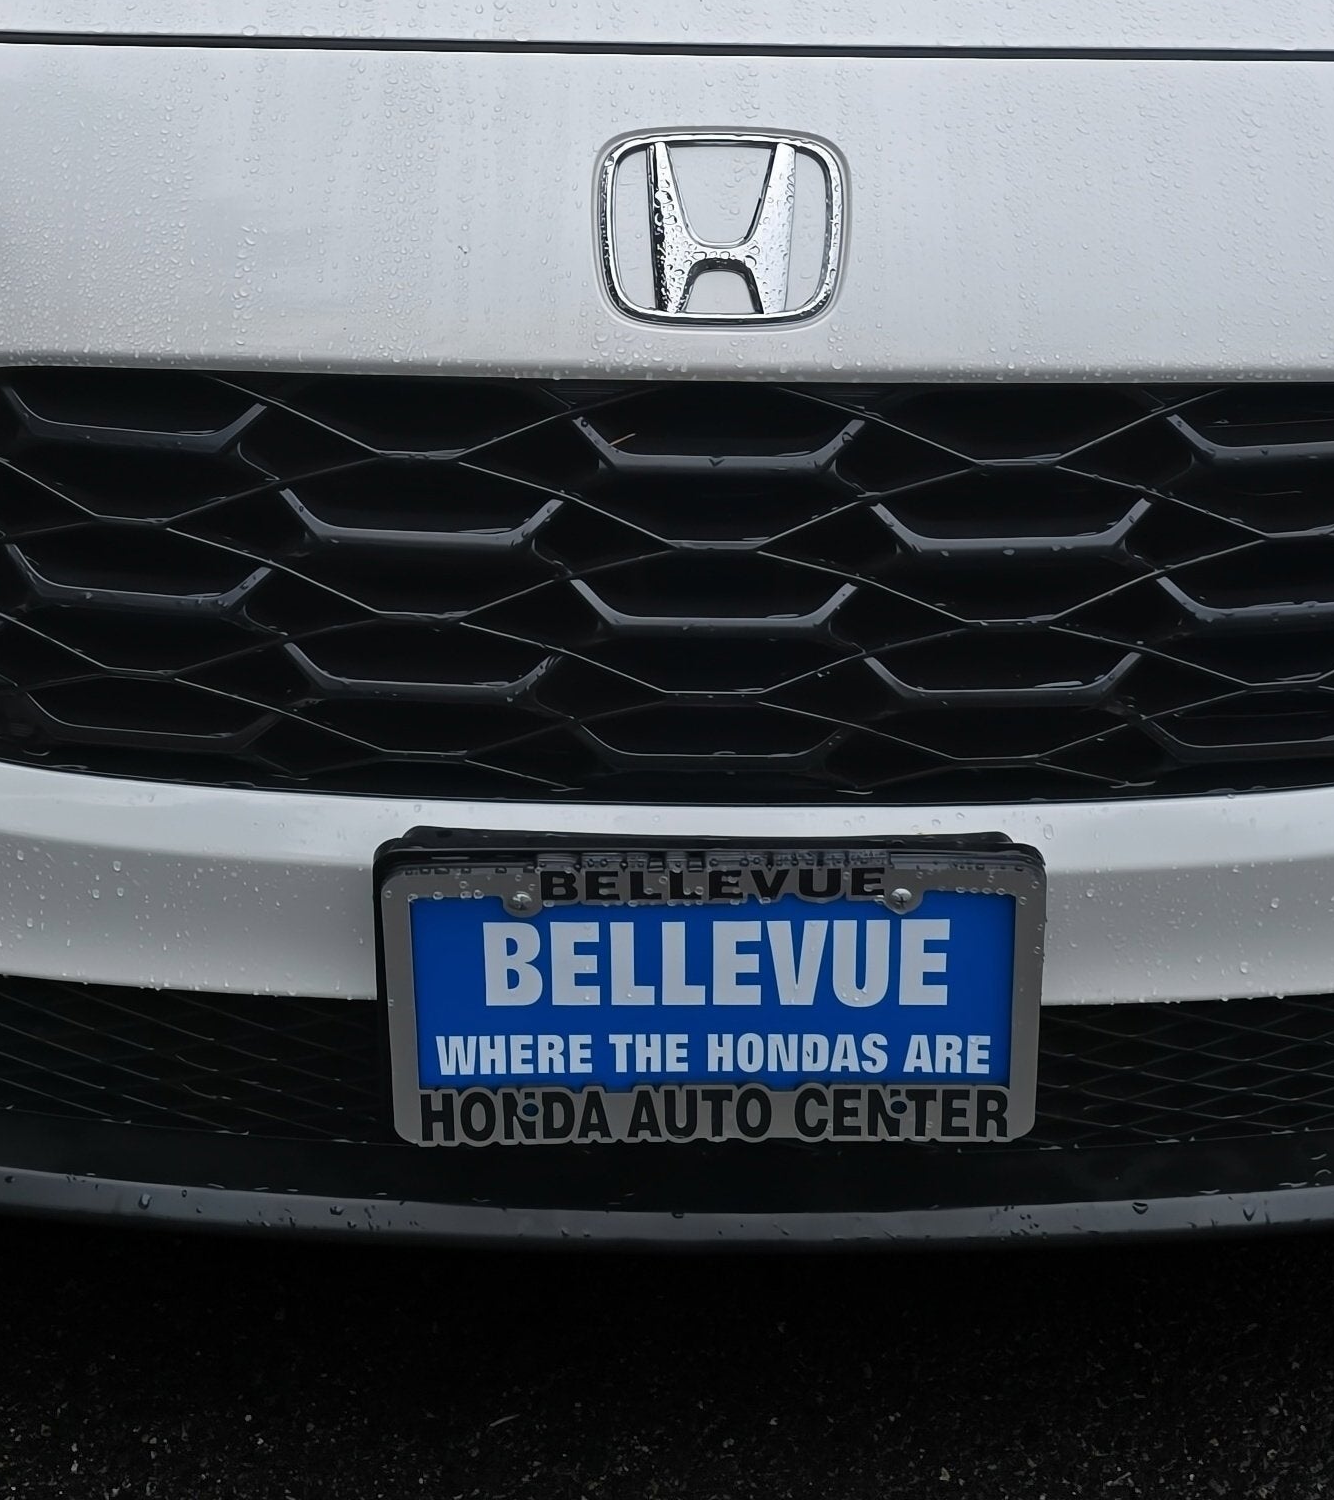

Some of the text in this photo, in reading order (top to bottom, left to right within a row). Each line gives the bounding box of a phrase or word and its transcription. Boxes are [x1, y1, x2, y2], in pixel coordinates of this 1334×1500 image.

[539, 867, 887, 903] BELLEVUE
[482, 918, 951, 1007] BELLEVUE
[436, 1033, 992, 1075] WHERE THE HONDAS ARE
[420, 1088, 1009, 1143] HONDA AUTO CENTER
